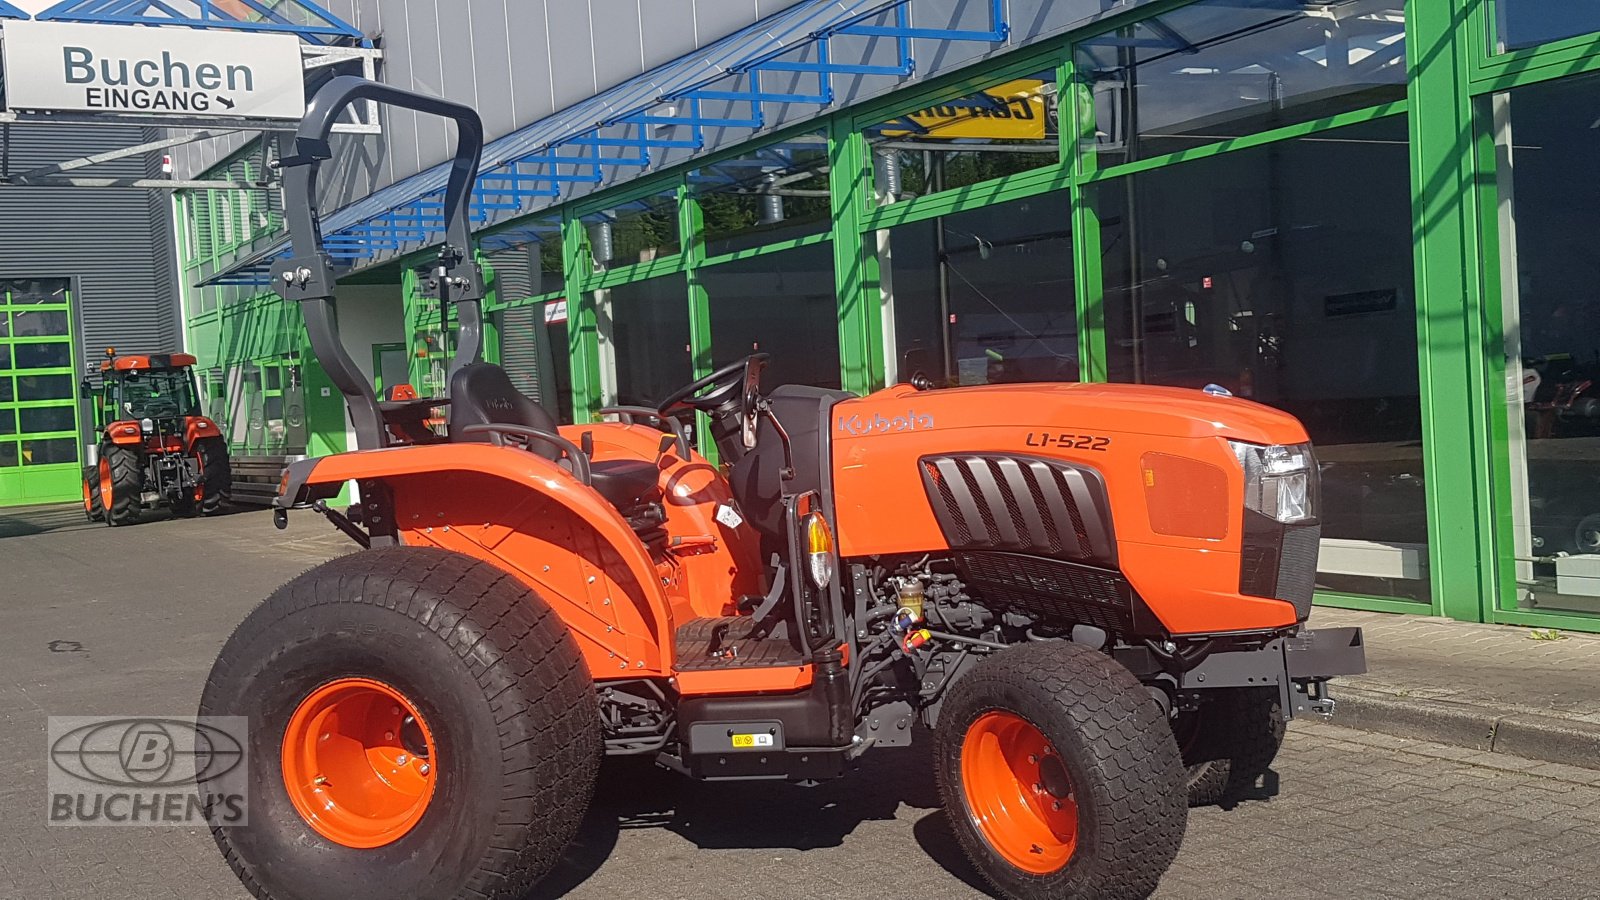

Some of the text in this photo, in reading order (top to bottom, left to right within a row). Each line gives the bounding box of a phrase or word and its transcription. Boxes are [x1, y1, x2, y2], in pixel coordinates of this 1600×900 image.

[62, 46, 254, 91] Buchen
[86, 87, 210, 110] EINGANG
[838, 409, 935, 435] Kubota
[1025, 432, 1111, 452] L1-522
